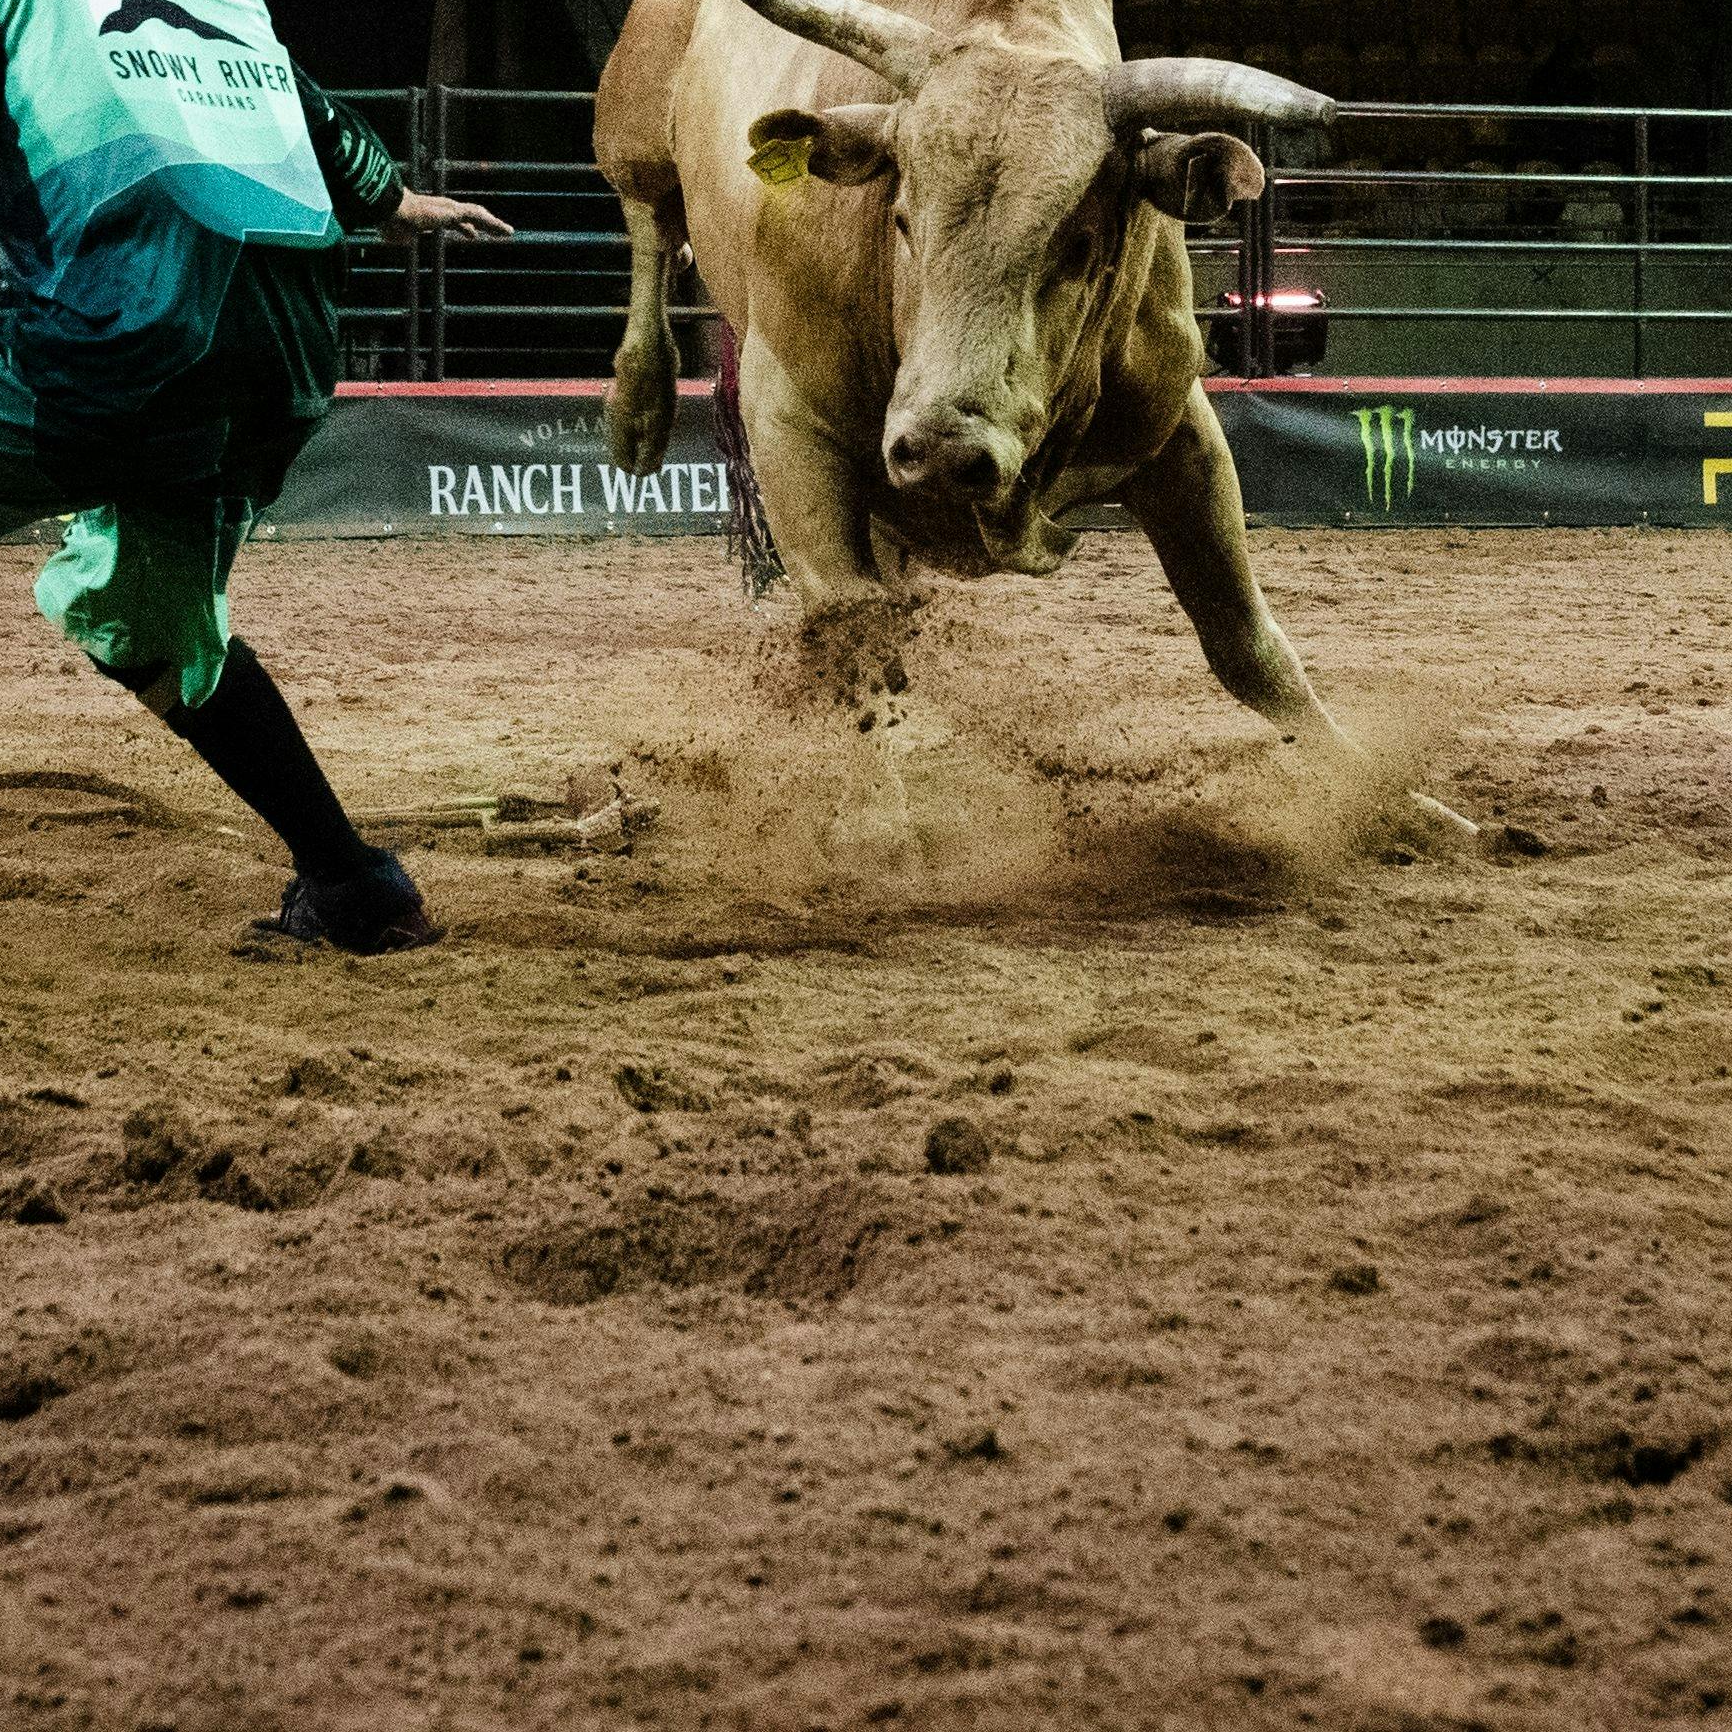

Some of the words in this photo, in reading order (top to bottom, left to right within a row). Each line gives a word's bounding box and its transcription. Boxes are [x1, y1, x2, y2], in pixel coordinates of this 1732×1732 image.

[108, 49, 203, 84] SNOWY
[217, 59, 293, 95] RIVER
[177, 88, 257, 111] CARAVANS
[1420, 424, 1564, 455] MONSTER
[1444, 458, 1543, 470] ENERGY
[428, 465, 585, 515] RANCH
